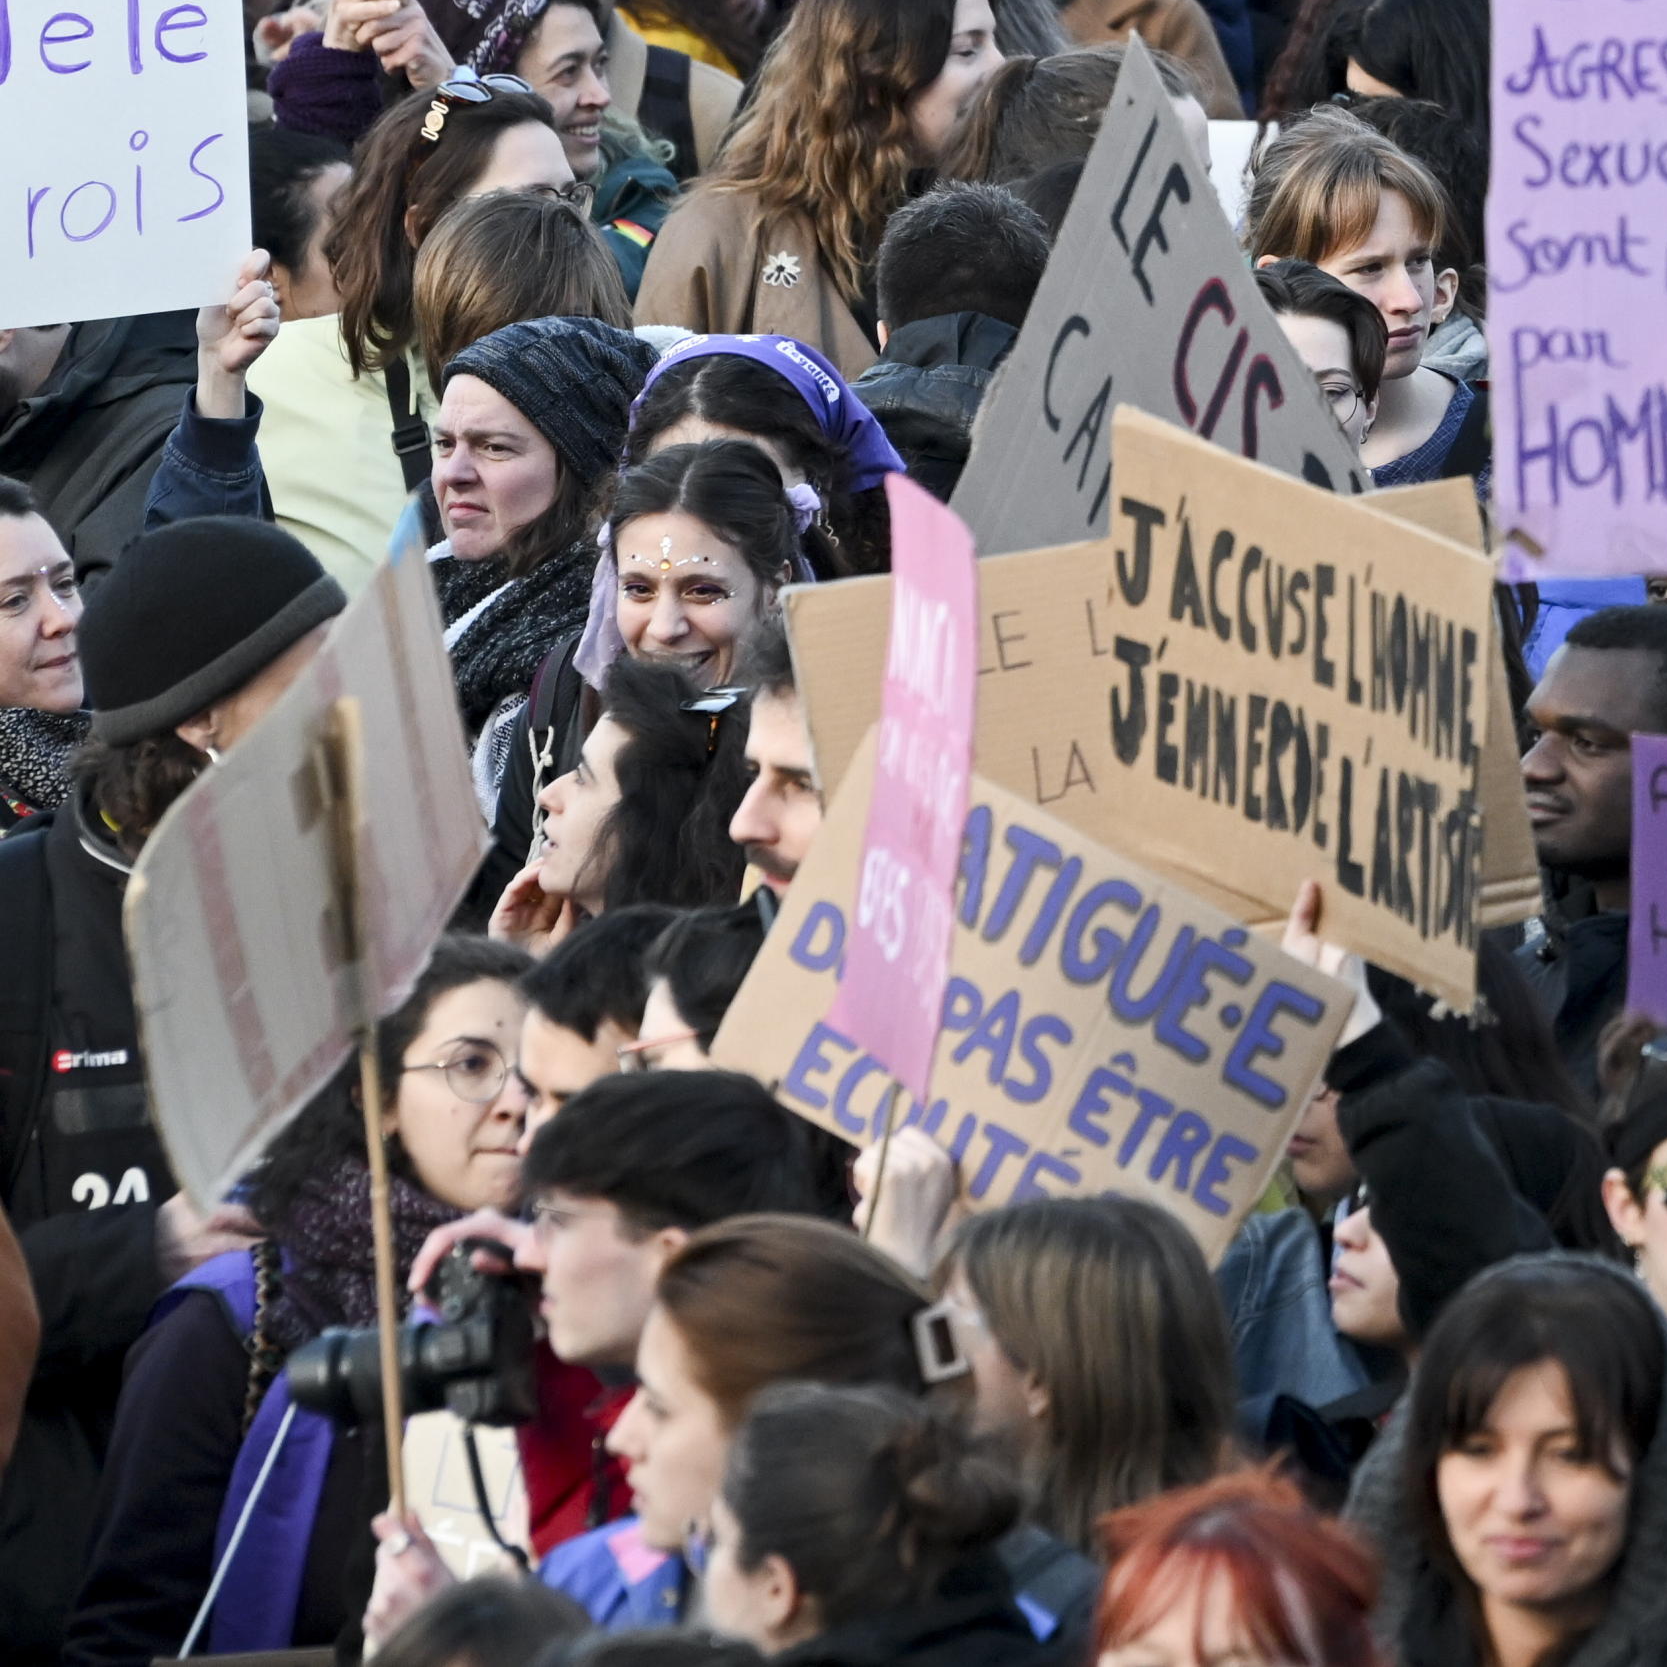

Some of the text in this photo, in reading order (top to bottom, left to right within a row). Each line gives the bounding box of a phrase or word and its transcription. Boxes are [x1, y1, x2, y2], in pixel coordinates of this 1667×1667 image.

[26, 128, 226, 260] rois
[1110, 115, 1193, 309] LE
[1114, 494, 1337, 693] J'ACCUSE
[1029, 738, 1098, 806] LA
[938, 973, 1075, 1106] PAS
[1065, 1049, 1261, 1219] ÊTRE
